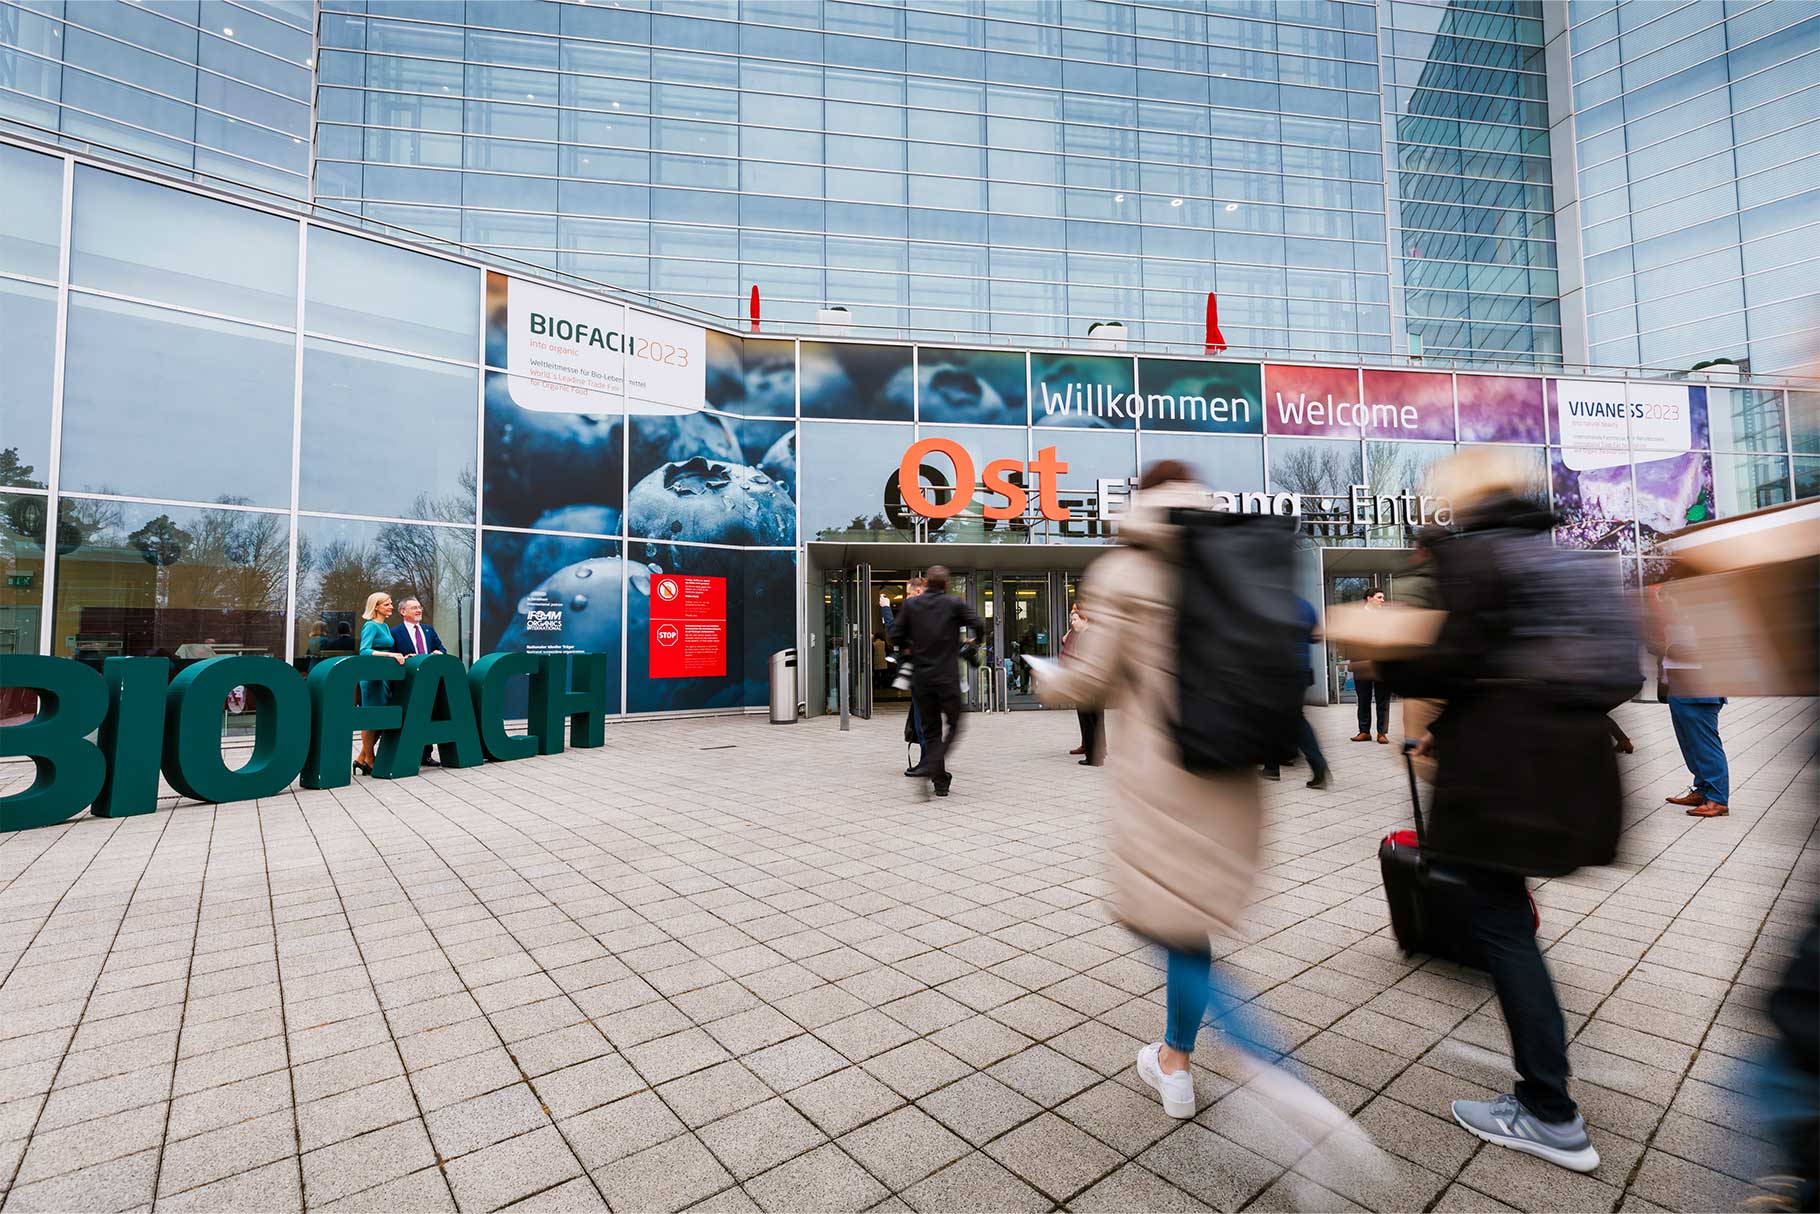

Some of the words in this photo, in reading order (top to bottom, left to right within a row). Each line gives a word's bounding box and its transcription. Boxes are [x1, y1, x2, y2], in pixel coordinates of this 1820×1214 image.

[529, 339, 547, 351] into
[548, 344, 579, 358] organic
[529, 358, 579, 375] Weltleitmesse
[590, 369, 648, 389] Bio-Lebenittel
[1040, 381, 1251, 423] Willkommen
[1275, 391, 1419, 430] Welcome
[898, 437, 1071, 521] Ost
[658, 631, 677, 639] STOP
[0, 653, 606, 832] BIOFACH
